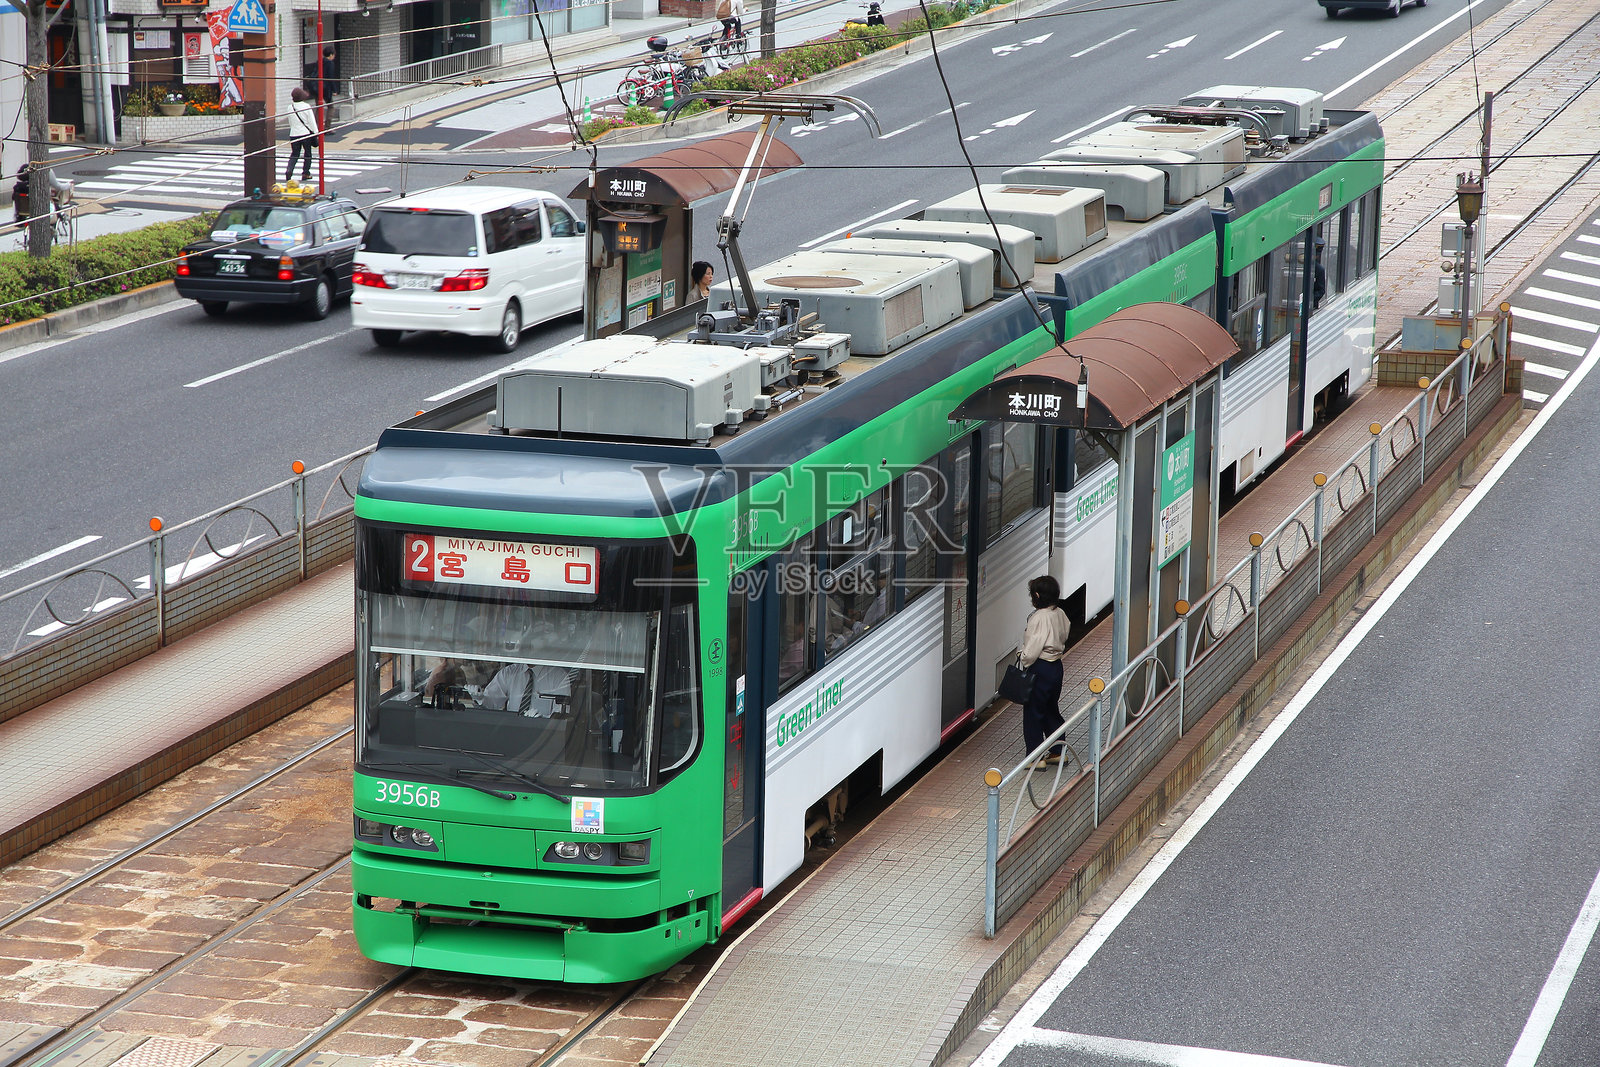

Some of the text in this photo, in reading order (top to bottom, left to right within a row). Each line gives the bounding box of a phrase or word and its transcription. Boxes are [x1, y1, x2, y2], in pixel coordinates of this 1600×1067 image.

[610, 179, 647, 192] 本川町
[1008, 392, 1062, 411] 本川町
[1009, 409, 1041, 417] HONKAWA
[1077, 496, 1099, 522] Green
[731, 509, 759, 544] 3956B
[411, 539, 429, 573] 2
[448, 539, 580, 558] MIYAJIMA GUCHI
[438, 551, 591, 585] 宮島口
[776, 677, 845, 747] Green Liner
[375, 781, 440, 808] 3956B
